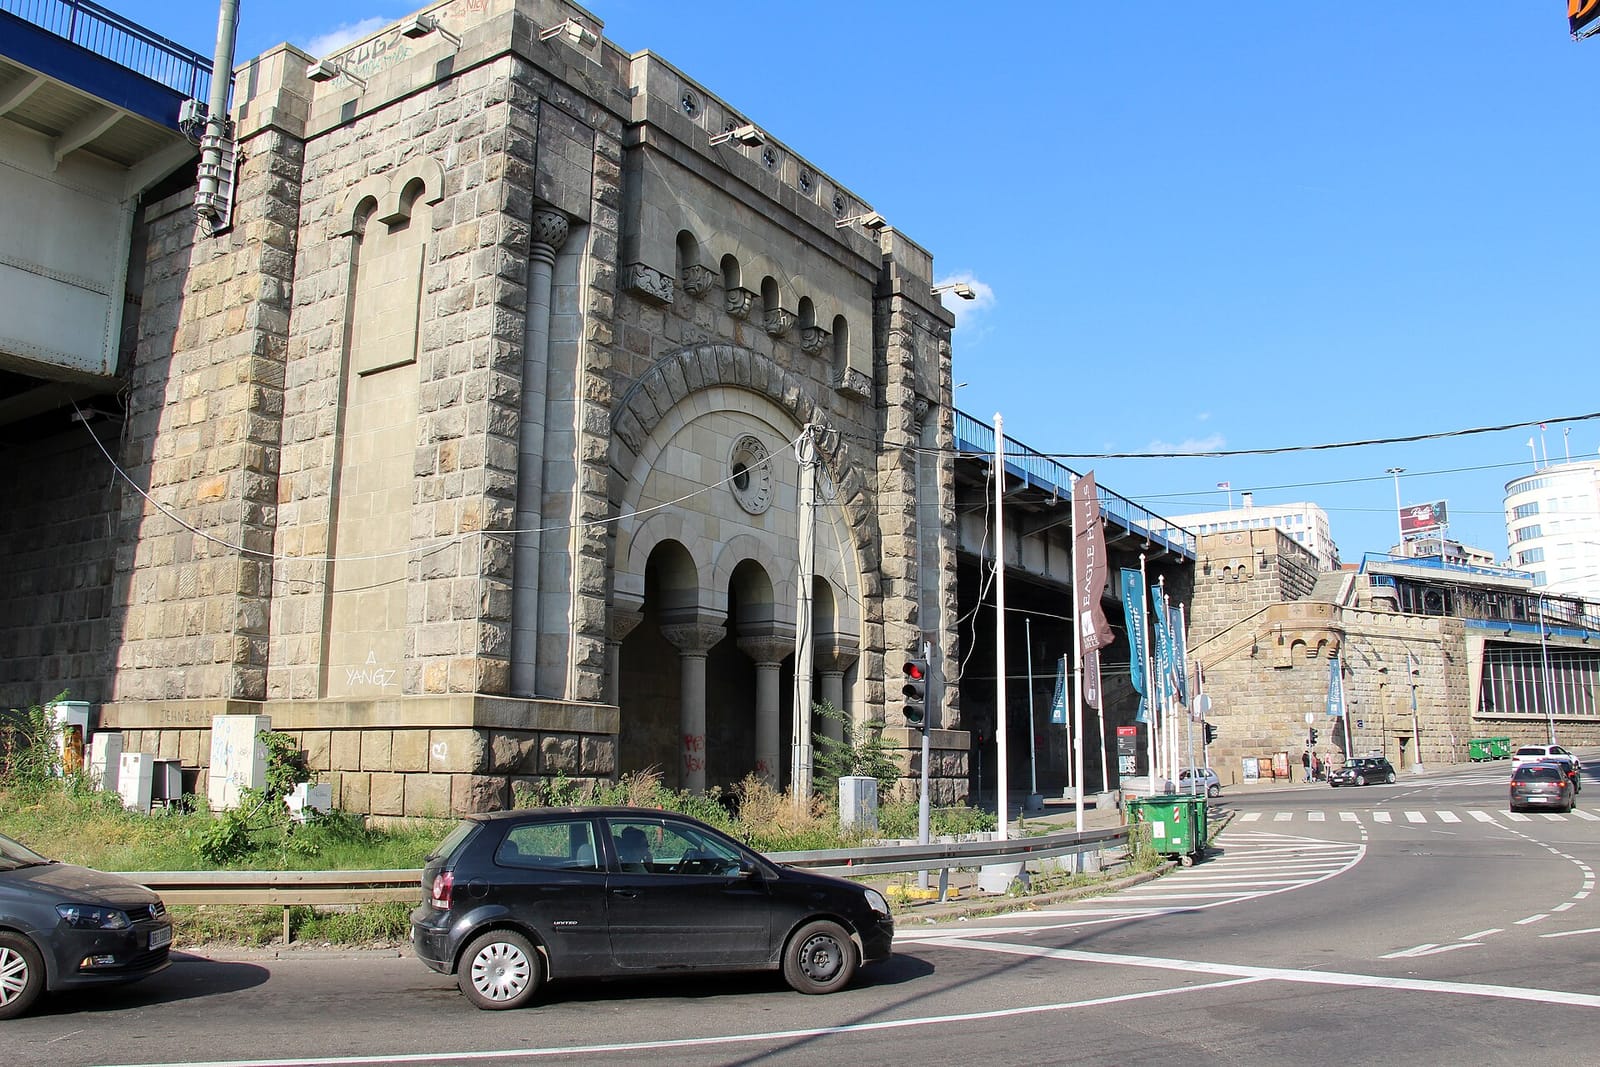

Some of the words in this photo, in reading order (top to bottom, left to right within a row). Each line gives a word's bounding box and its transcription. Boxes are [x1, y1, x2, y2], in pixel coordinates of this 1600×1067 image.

[1083, 484, 1095, 541] HILLS
[1083, 545, 1095, 607] EAGLE
[345, 668, 398, 687] YANGZ
